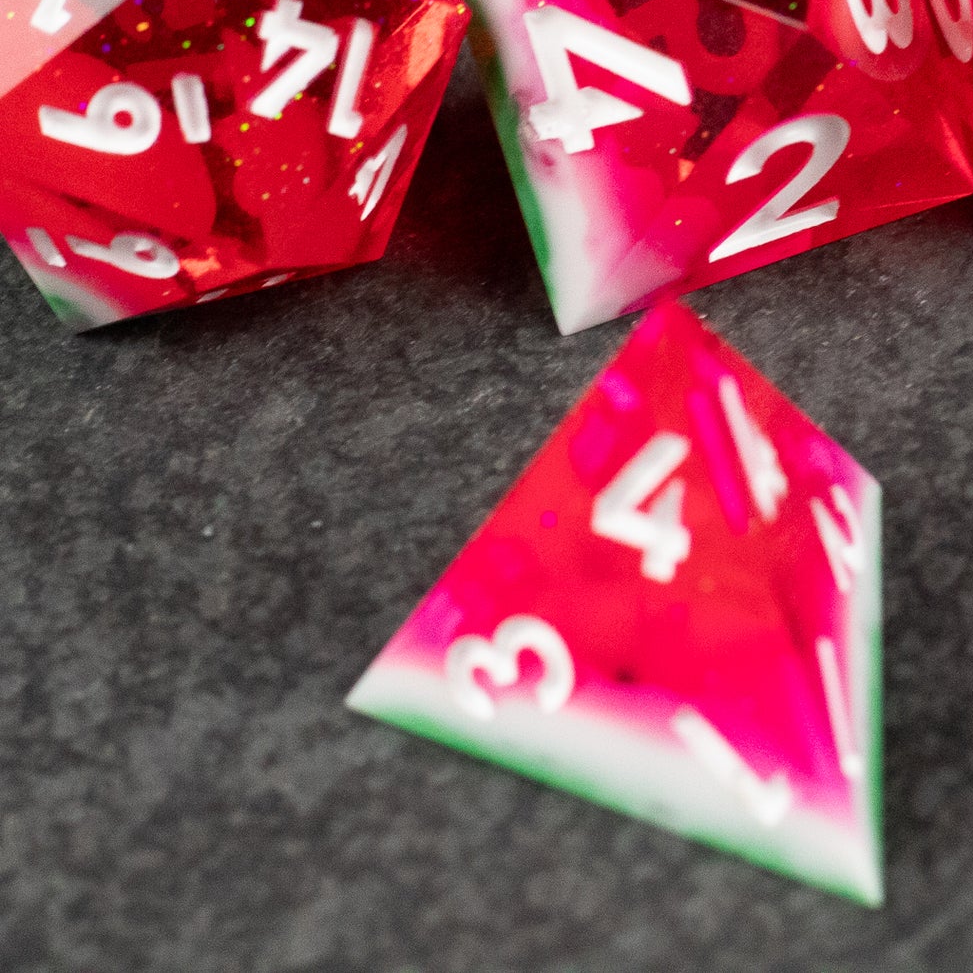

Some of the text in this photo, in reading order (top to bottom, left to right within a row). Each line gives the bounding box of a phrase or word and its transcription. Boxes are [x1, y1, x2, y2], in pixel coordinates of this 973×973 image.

[524, 4, 692, 154] 4
[708, 113, 851, 263] 2
[591, 430, 692, 583] 4
[445, 615, 576, 721] 3
